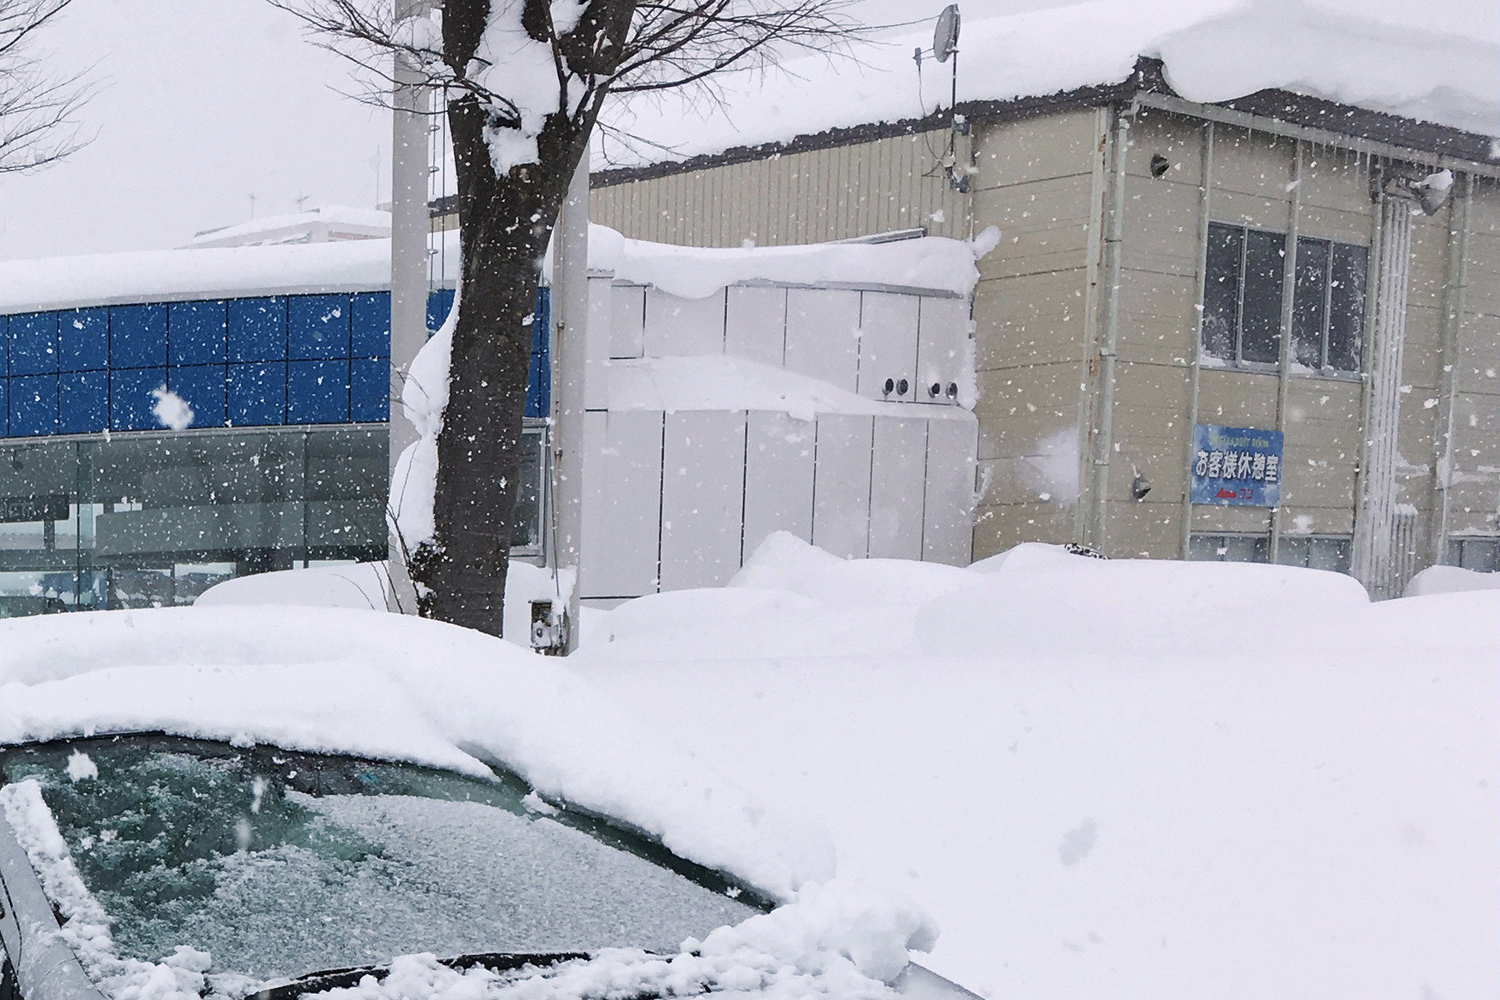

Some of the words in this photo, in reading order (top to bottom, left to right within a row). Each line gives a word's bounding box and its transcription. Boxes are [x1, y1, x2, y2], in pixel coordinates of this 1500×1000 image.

[1196, 449, 1279, 481] お客様休憩室
